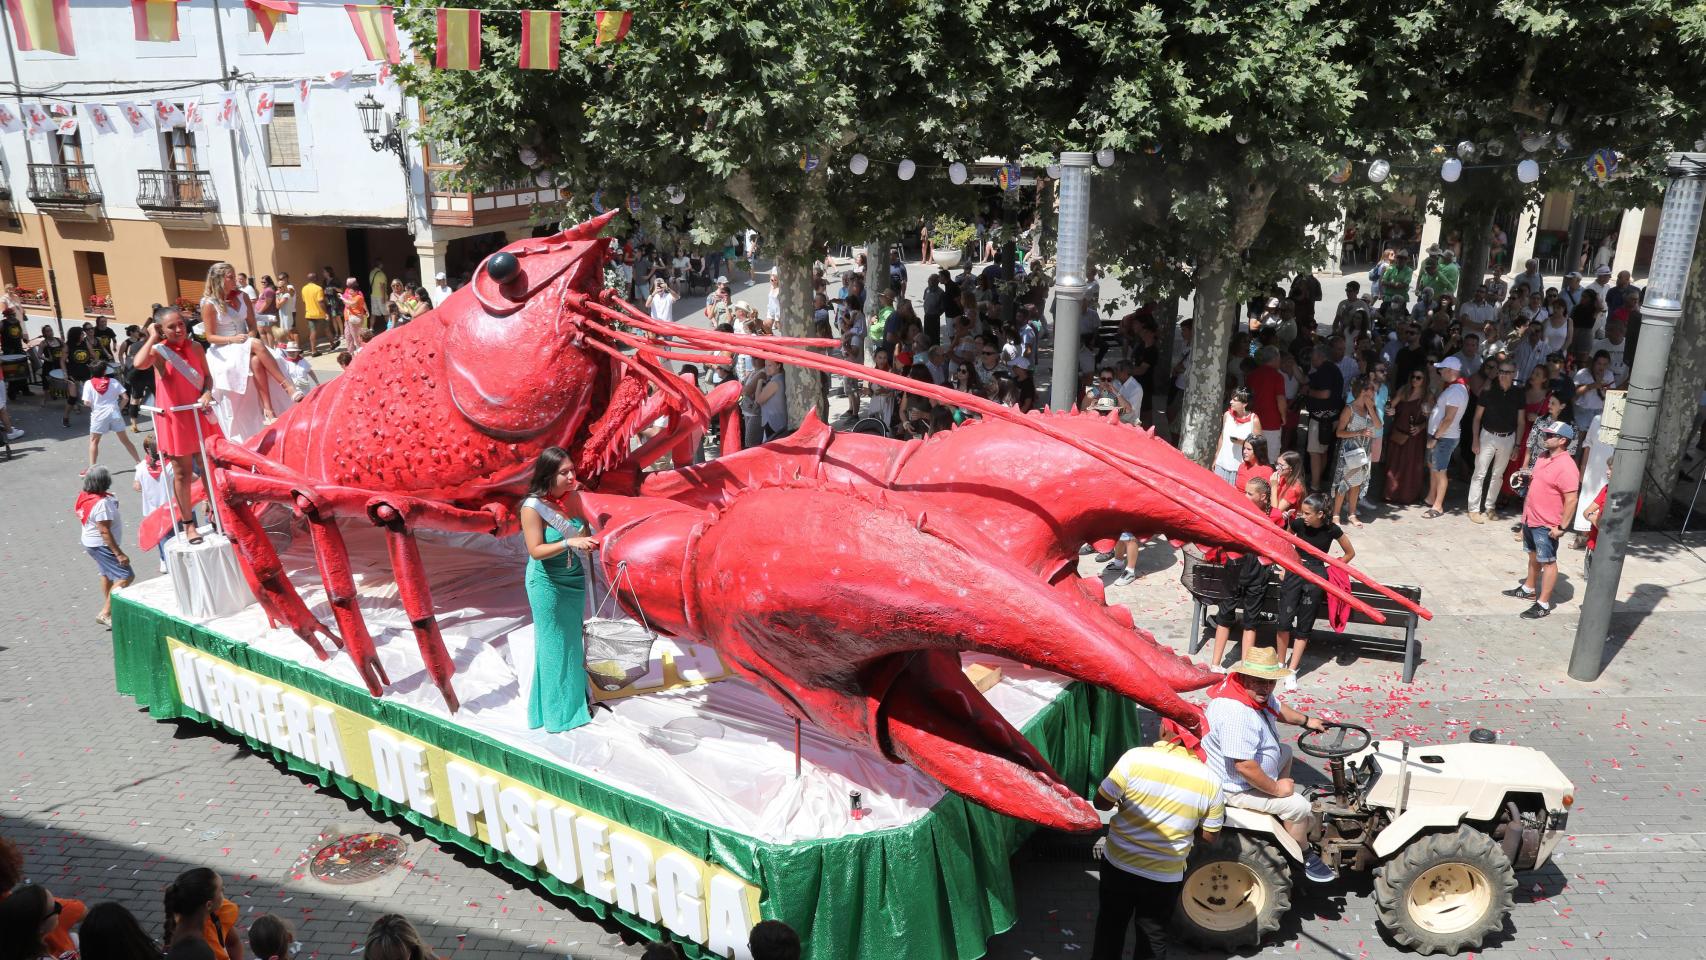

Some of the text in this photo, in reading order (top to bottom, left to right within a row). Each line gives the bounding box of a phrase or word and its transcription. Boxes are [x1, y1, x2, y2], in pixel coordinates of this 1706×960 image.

[172, 646, 757, 959] HERRERA DE PISUERGA
